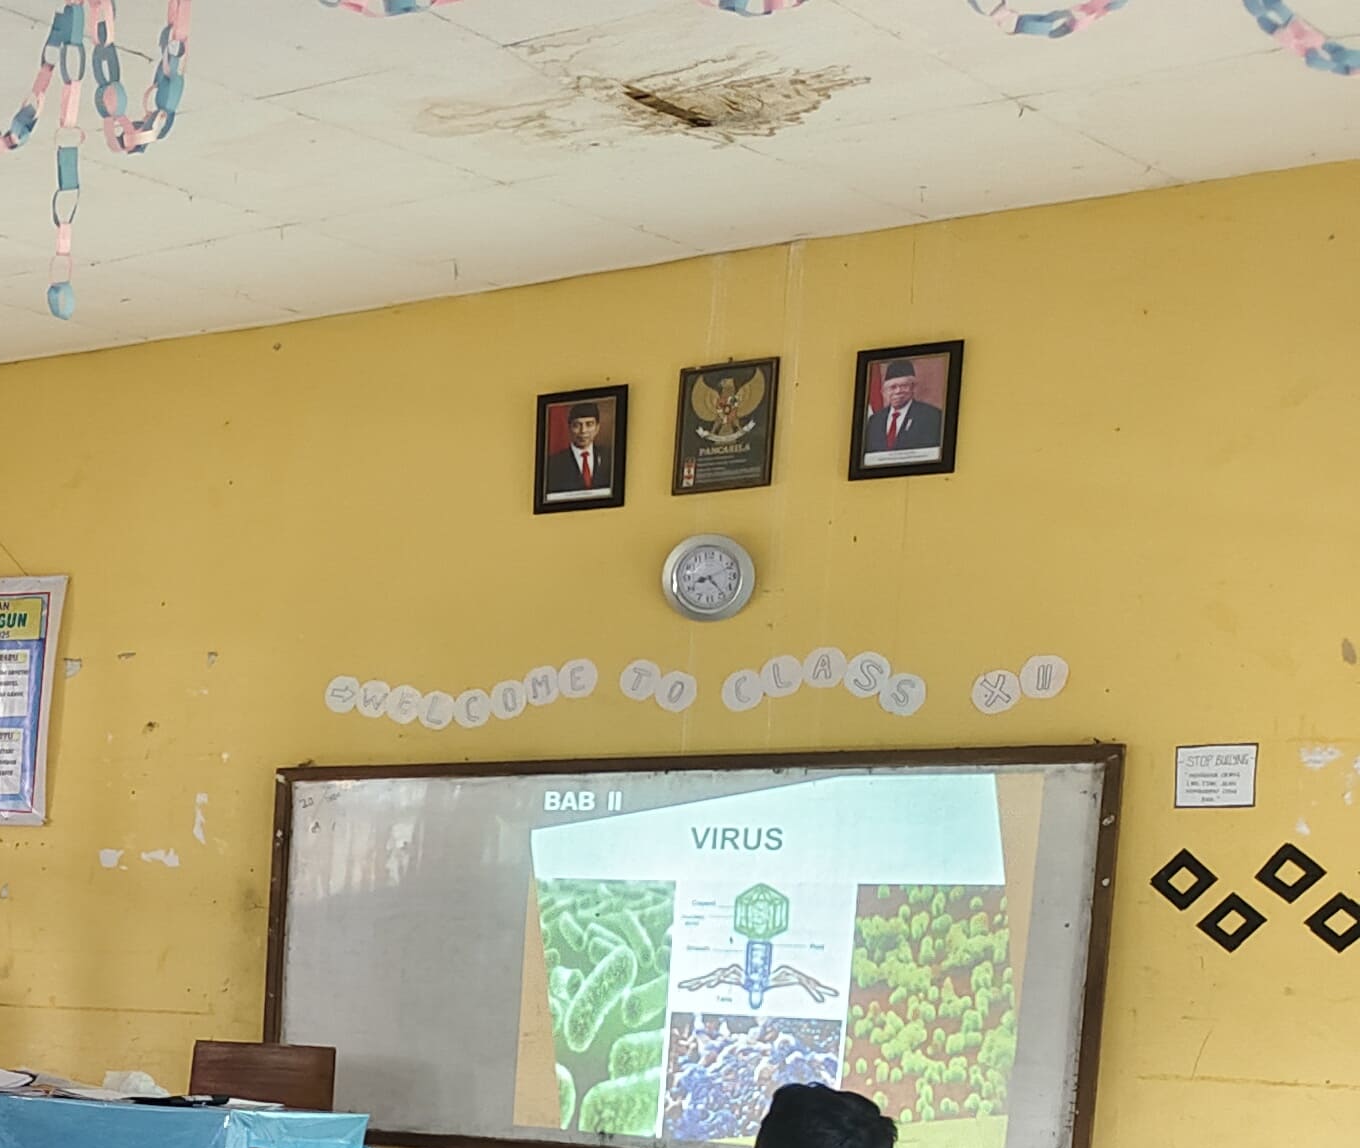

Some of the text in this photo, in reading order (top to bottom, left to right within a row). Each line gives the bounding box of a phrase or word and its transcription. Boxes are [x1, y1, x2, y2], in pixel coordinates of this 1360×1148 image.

[362, 665, 586, 726] WELCOME
[630, 666, 685, 704] TO
[733, 653, 916, 708] CLASS
[1185, 754, 1214, 768] STOP
[544, 791, 595, 811] BAB
[691, 827, 784, 851] VIRUS
